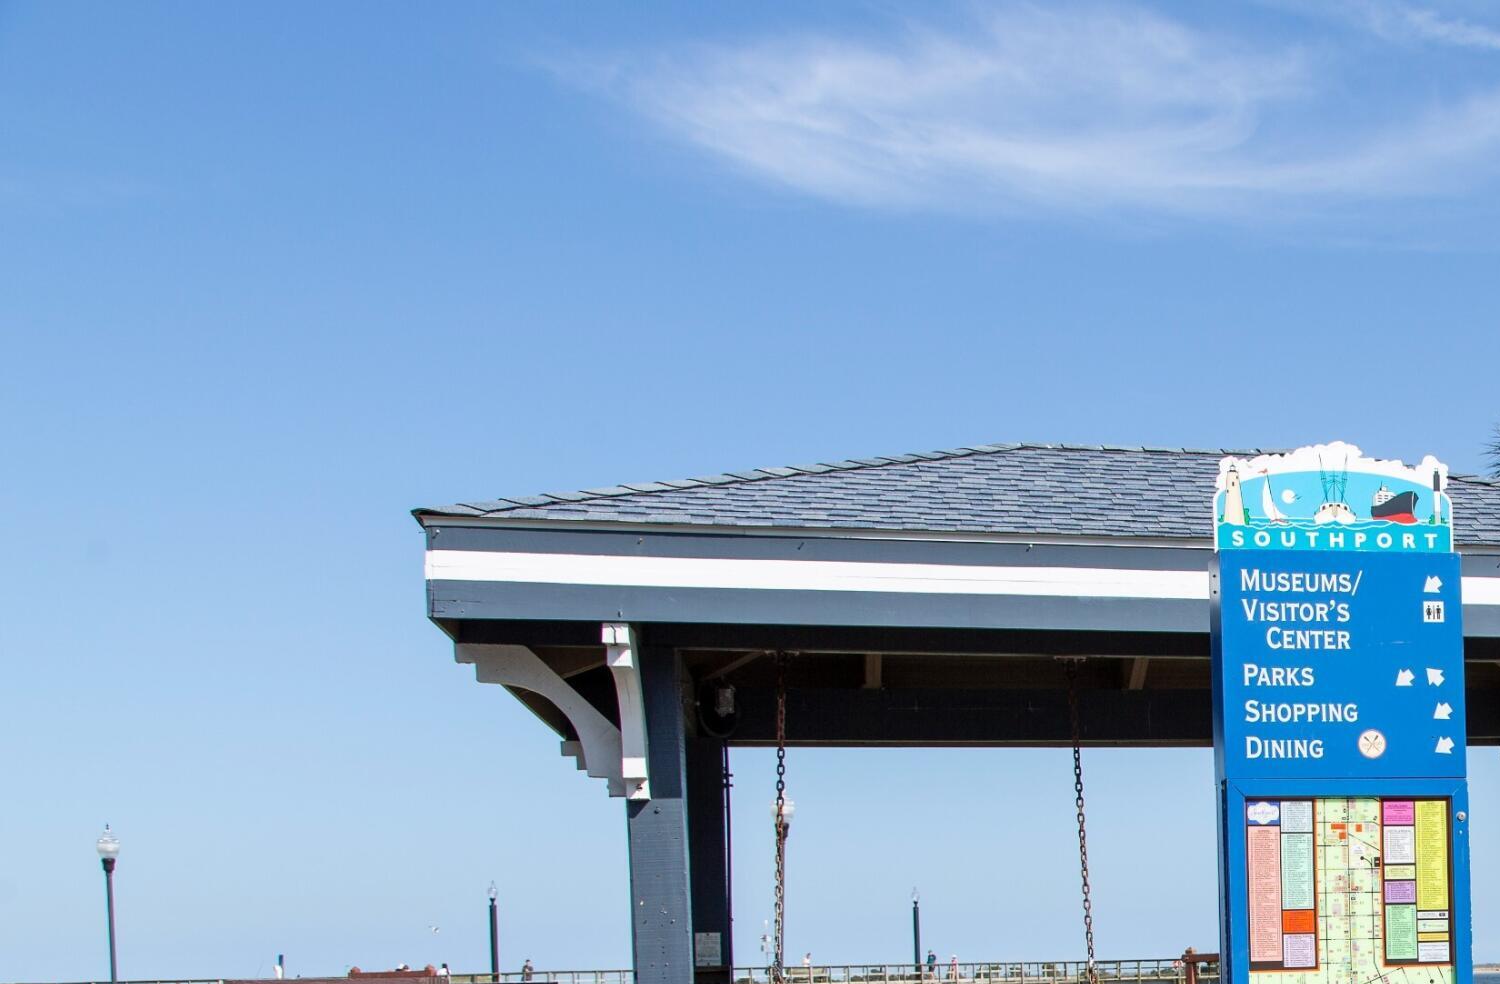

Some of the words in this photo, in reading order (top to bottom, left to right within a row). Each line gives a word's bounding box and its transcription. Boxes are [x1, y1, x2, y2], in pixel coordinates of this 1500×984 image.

[1231, 530, 1438, 549] SOUTHPORT
[1240, 568, 1363, 595] MUSEUMS/
[1241, 599, 1350, 622] VISITOR'S
[1266, 627, 1351, 650] CENTER
[1243, 663, 1314, 687] PARKS
[1245, 700, 1358, 722] SHOPPING
[1245, 736, 1324, 759] DINING
